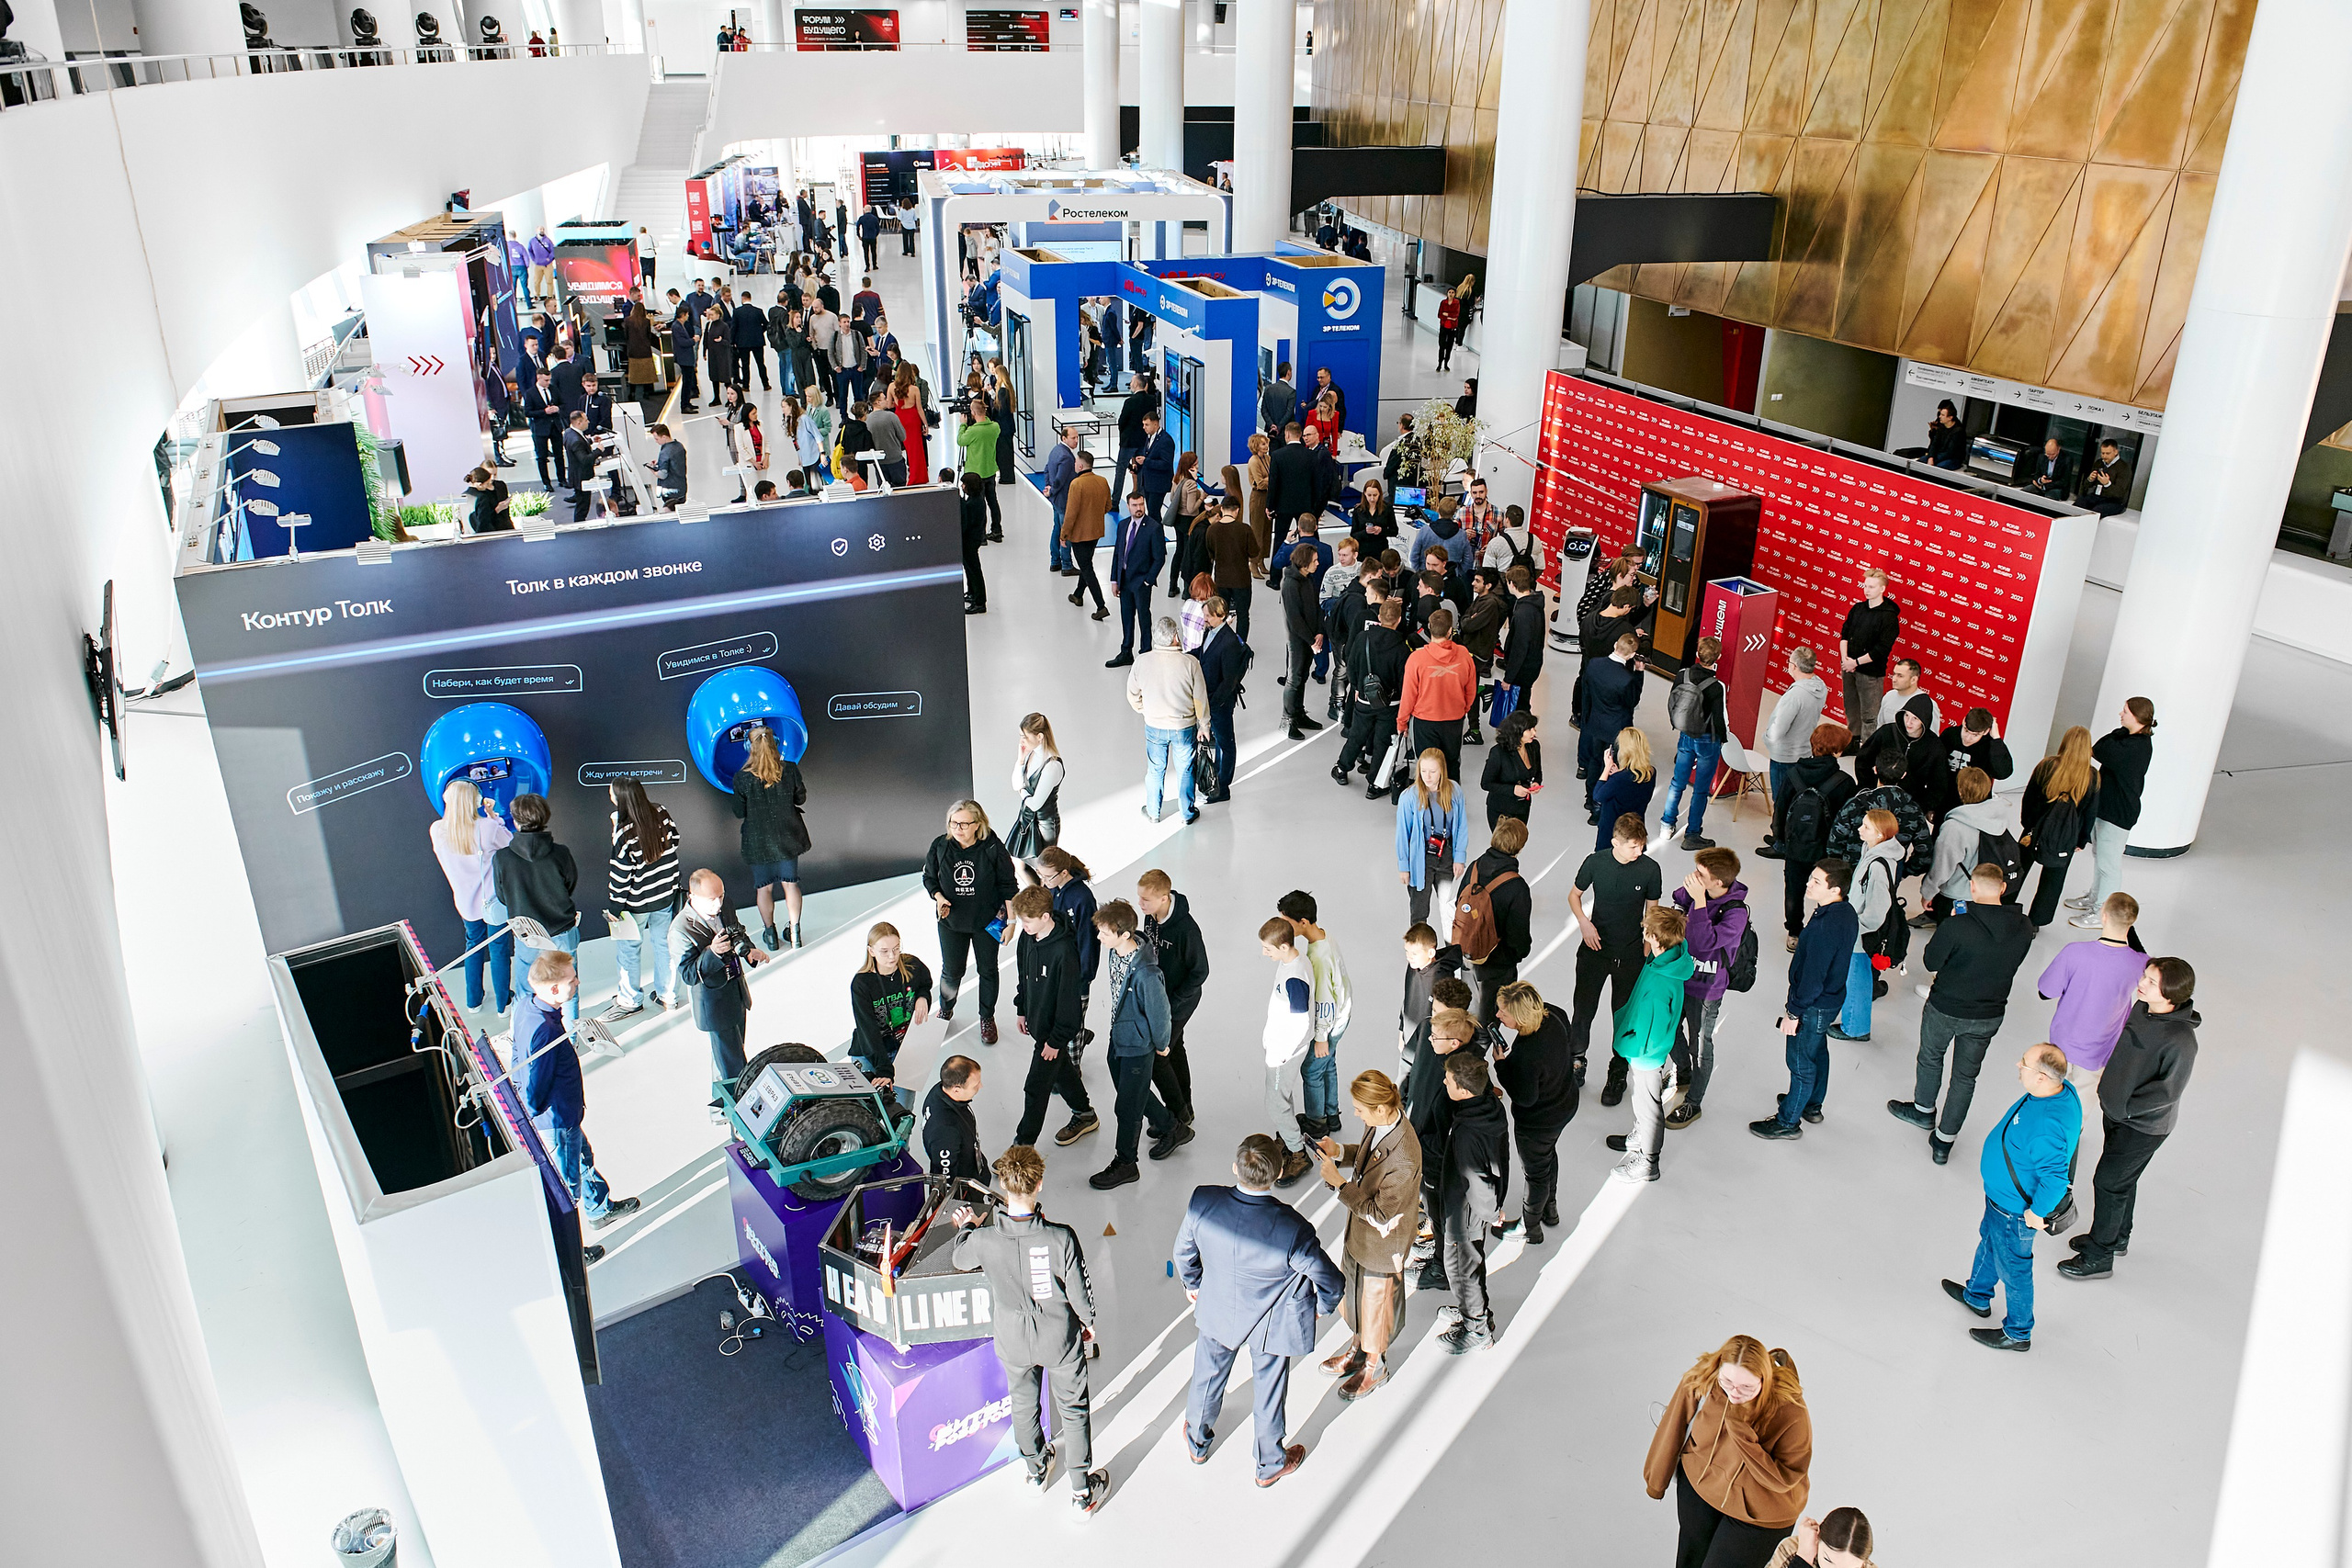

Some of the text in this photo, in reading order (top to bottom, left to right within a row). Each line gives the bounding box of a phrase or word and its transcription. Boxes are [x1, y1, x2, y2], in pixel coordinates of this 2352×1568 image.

[802, 16, 831, 24] ФОРУМ
[1063, 209, 1128, 218] Ростелеком
[567, 281, 623, 290] УВИДИМСЯ
[2019, 552, 2032, 560] 2023
[505, 560, 703, 595] Толк в каждом звонке
[1975, 581, 1987, 590] 2023
[2010, 593, 2023, 602] 2023
[241, 599, 394, 631] Контур Толк
[1967, 622, 1979, 630] 2023
[2002, 635, 2014, 643] 2023
[665, 654, 710, 670] Увидимся
[718, 647, 745, 659] Толке
[433, 676, 554, 688] Набери, как будет время
[1994, 674, 2006, 682] 2023
[834, 702, 898, 712] Давай обсудим
[1951, 700, 1962, 708] 2023
[585, 771, 605, 779] Жду
[630, 769, 662, 777] встречи
[296, 786, 333, 804] Покажу
[342, 768, 385, 789] расскажу
[765, 1085, 778, 1102] ЕВРАЗ
[826, 1264, 991, 1331] HEAD LINER
